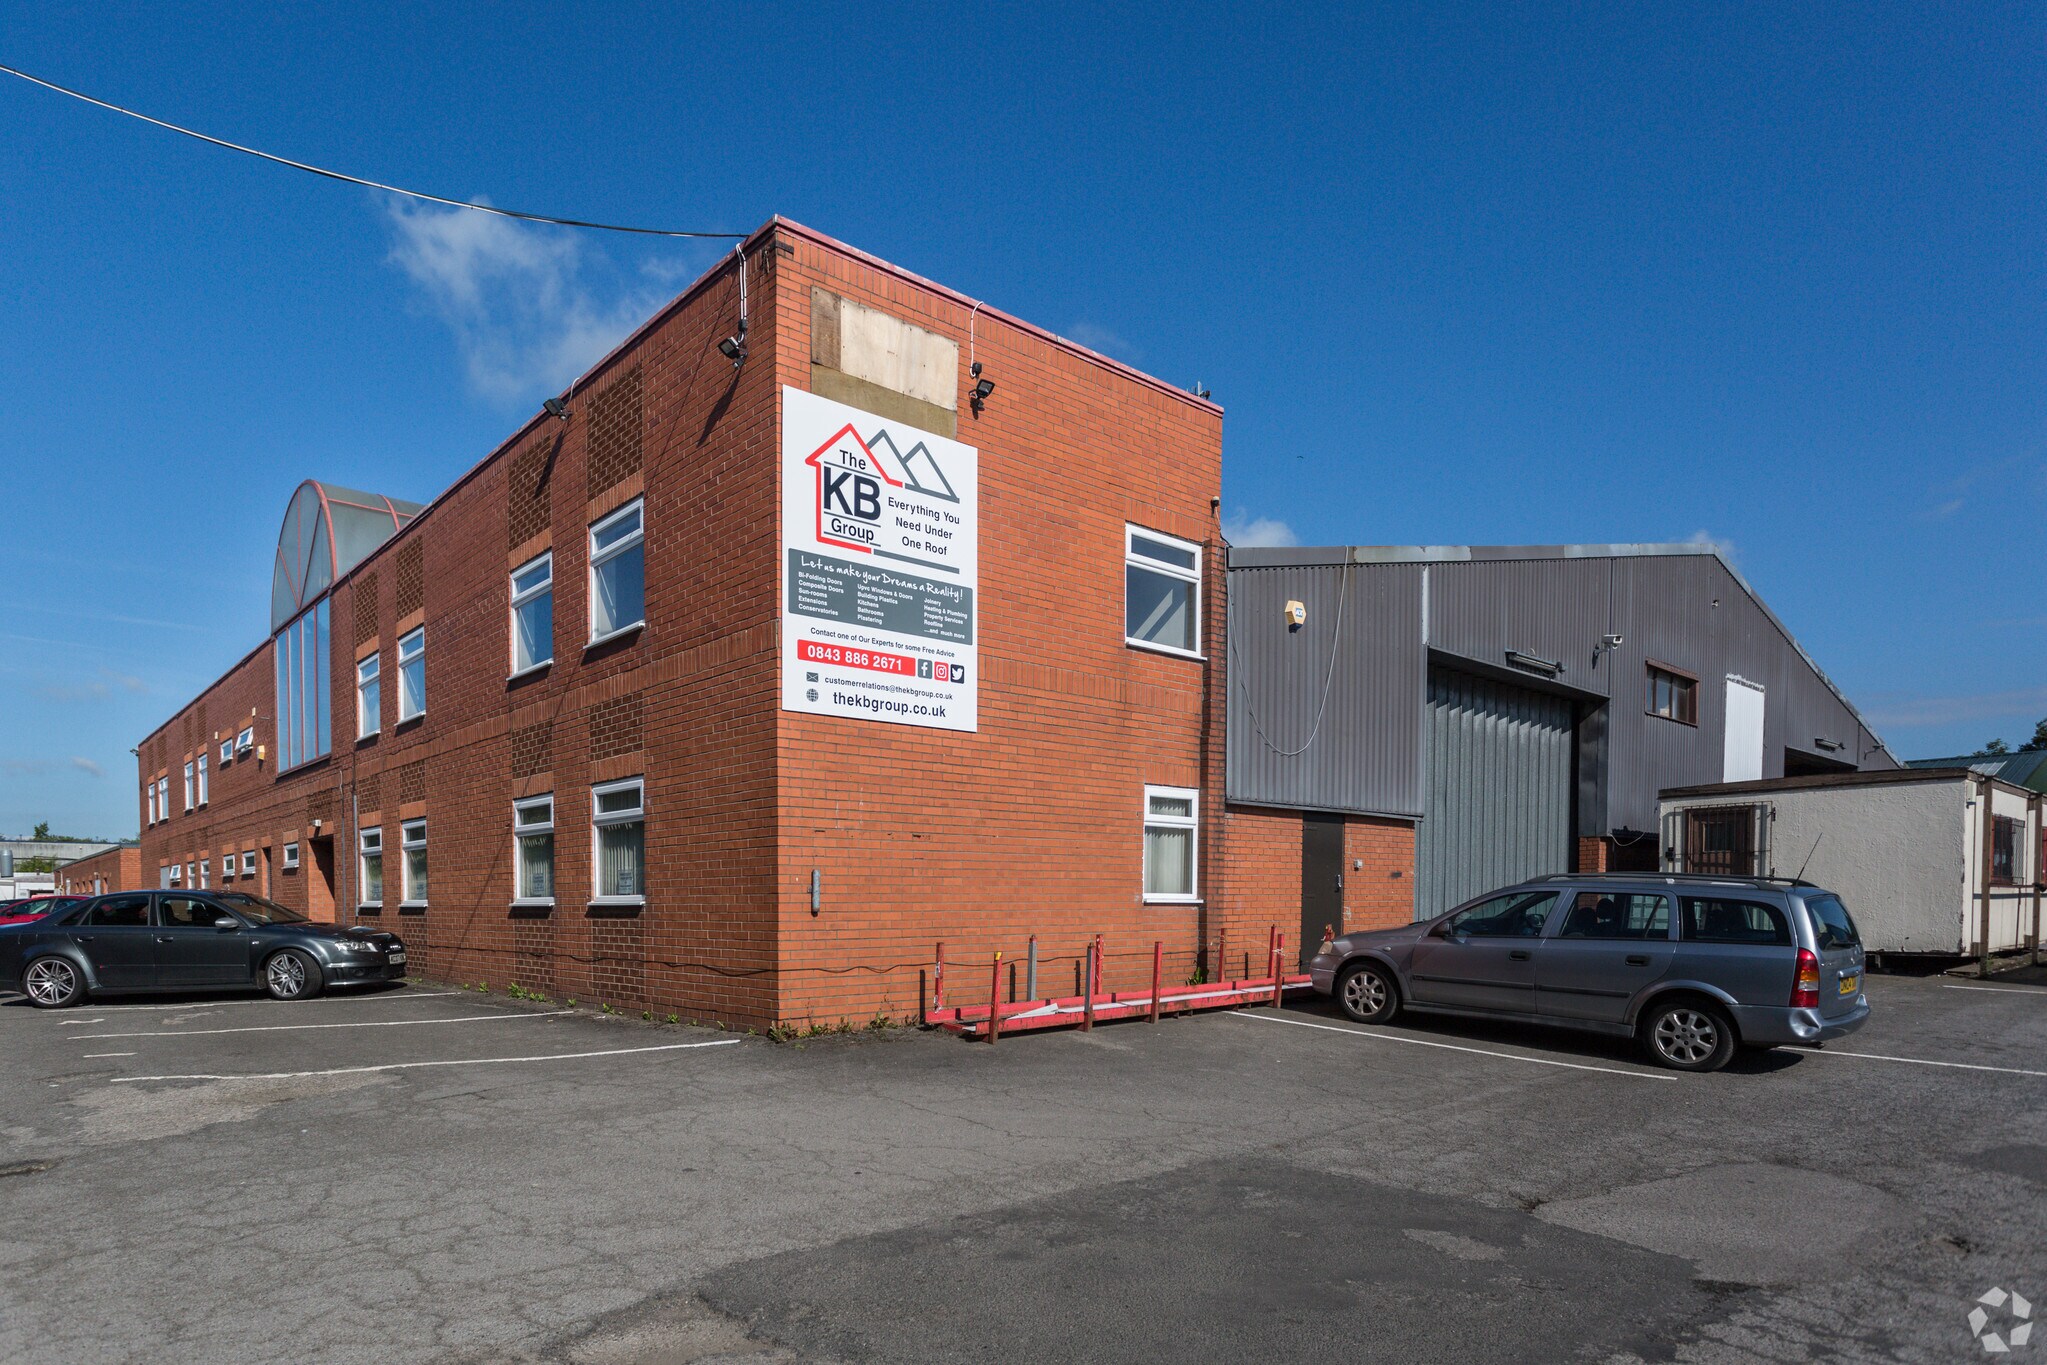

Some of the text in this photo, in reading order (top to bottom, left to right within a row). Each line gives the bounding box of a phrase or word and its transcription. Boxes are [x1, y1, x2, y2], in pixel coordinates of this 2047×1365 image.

[840, 450, 866, 470] The
[824, 466, 881, 521] KB
[889, 497, 960, 524] Everything You
[831, 518, 874, 543] Group
[896, 517, 952, 539] Need Under
[902, 536, 947, 555] One Roof
[798, 580, 827, 590] Composite
[801, 555, 823, 570] Let
[837, 564, 861, 577] make
[862, 571, 881, 584] your
[881, 573, 917, 590] Dreams
[926, 583, 963, 603] Reality!
[827, 577, 842, 586] Doors
[798, 588, 827, 598] Sun-rooms
[871, 586, 893, 596] Windows
[798, 596, 827, 606] Extensions
[857, 592, 898, 604] Building Plastics
[857, 600, 879, 608] Kitchens
[924, 598, 941, 606] Joinery
[798, 604, 838, 616] Conservatories
[857, 607, 884, 616] Bathrooms
[924, 605, 941, 614] Heating
[947, 610, 968, 620] Plumbing
[857, 615, 882, 625] Plastering
[924, 612, 963, 624] Property Services
[924, 619, 943, 628] Roofline
[810, 627, 836, 638] Contact
[872, 638, 894, 648] Experts
[936, 649, 955, 658] Advice
[807, 645, 902, 671] 0843 886 2671
[825, 676, 953, 700] customerrelations@thekbgroup.co.uk
[833, 692, 946, 717] thekbgroup.co.uk
